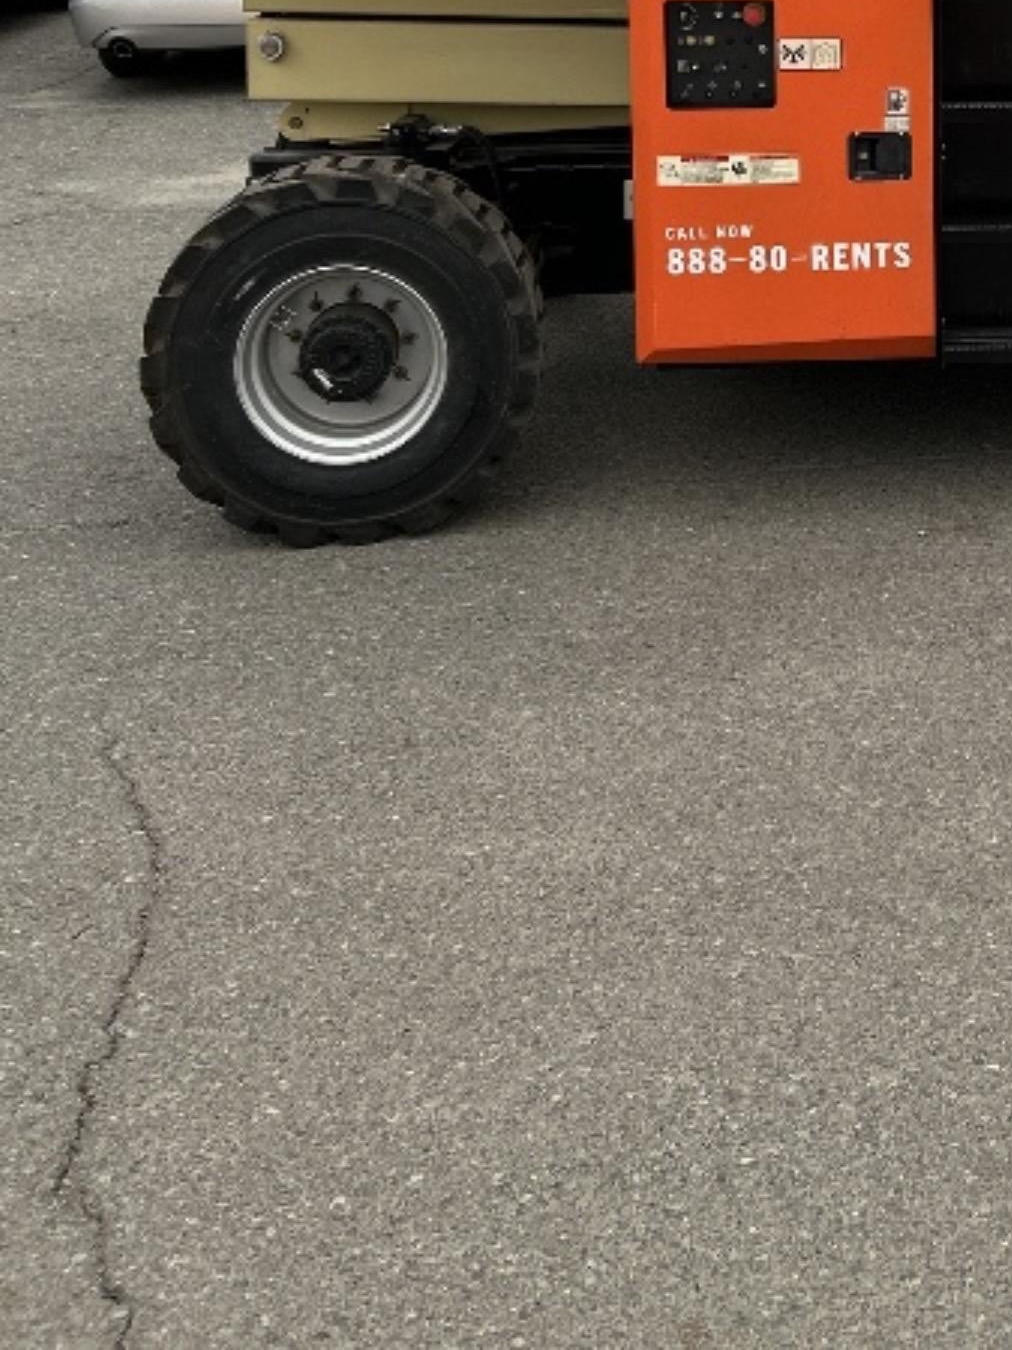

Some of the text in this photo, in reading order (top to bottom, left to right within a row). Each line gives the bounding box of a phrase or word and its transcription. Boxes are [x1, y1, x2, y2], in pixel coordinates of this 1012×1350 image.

[664, 224, 753, 241] CALL NOW
[666, 242, 912, 276] 888-80-RENTS
